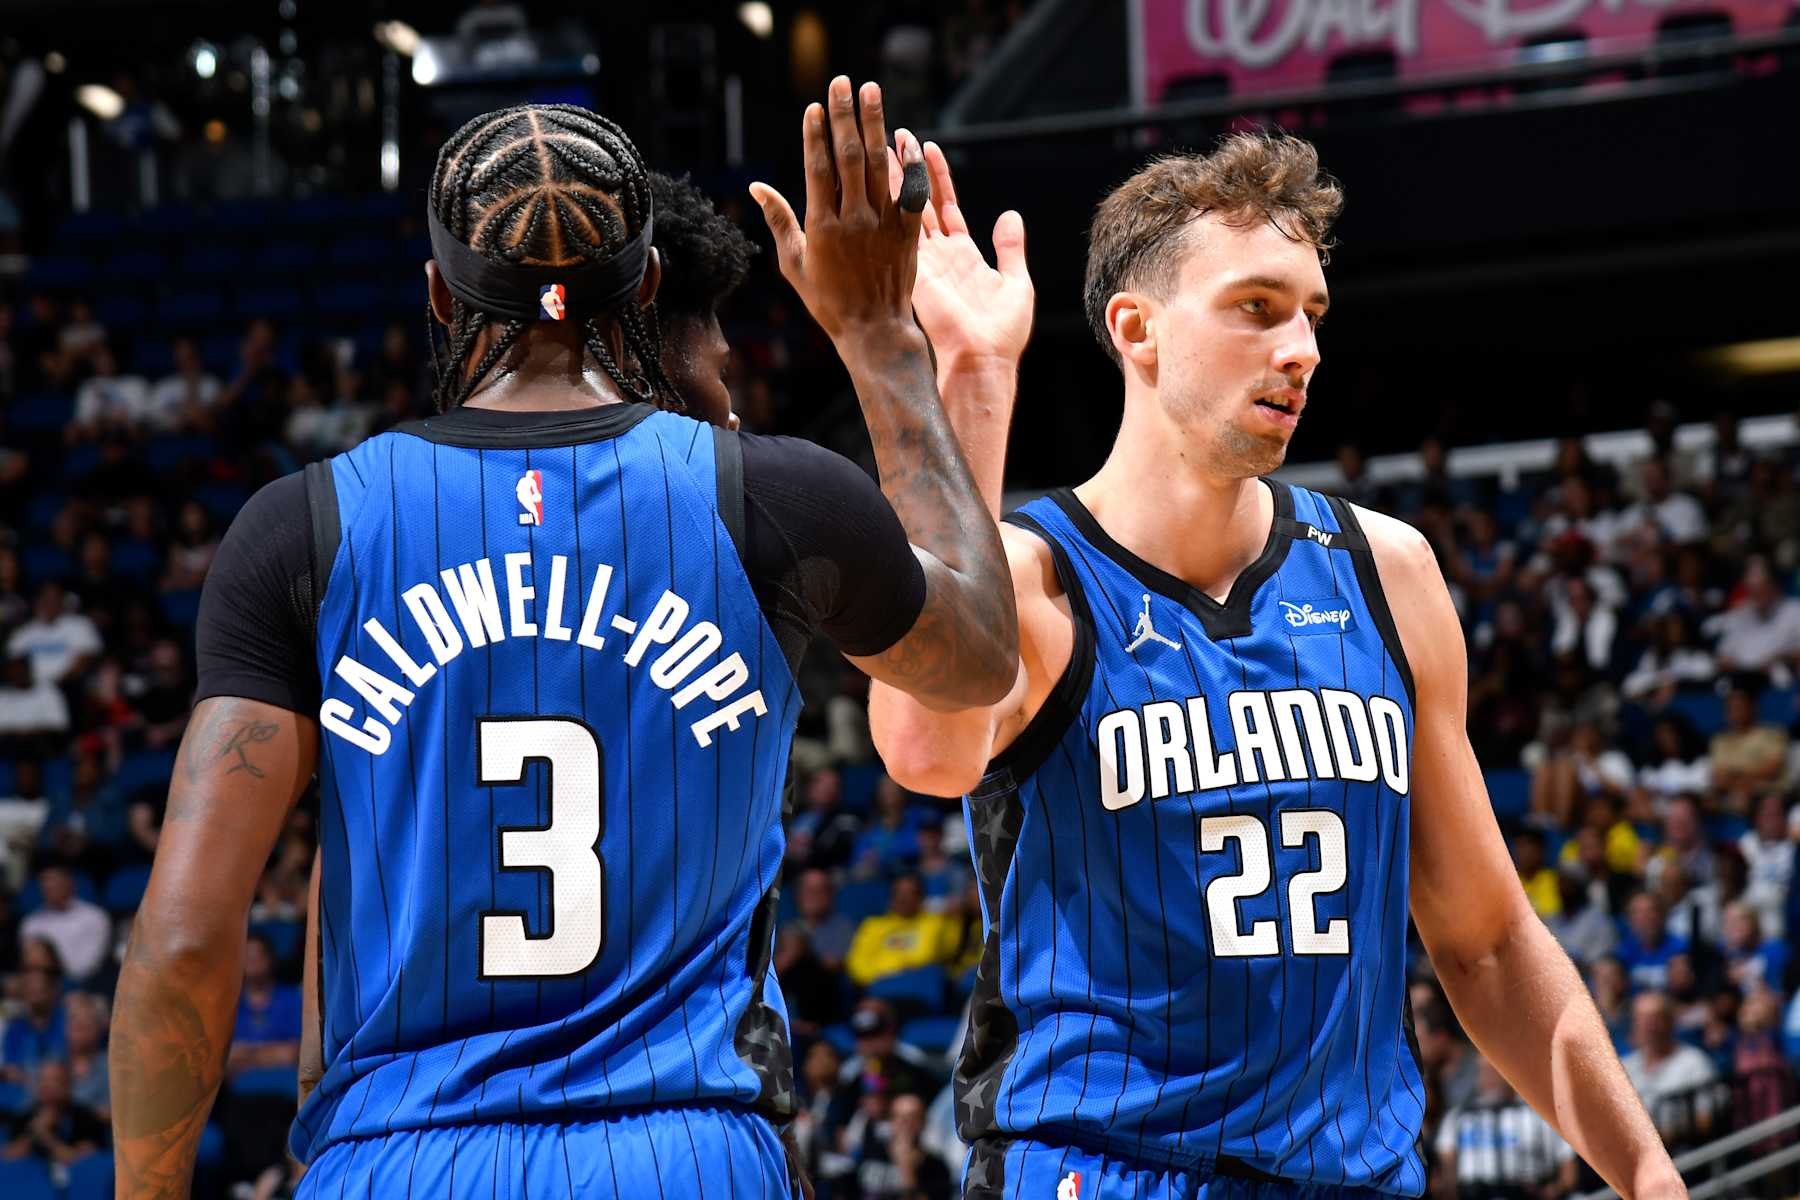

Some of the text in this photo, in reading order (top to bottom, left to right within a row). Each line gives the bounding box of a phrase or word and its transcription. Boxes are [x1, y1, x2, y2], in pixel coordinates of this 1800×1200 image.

[1307, 525, 1333, 546] PW
[320, 552, 768, 756] CALDWELL-POPE
[1098, 687, 1409, 811] ORLANDO
[479, 718, 603, 977] 3
[1200, 810, 1350, 957] 22
